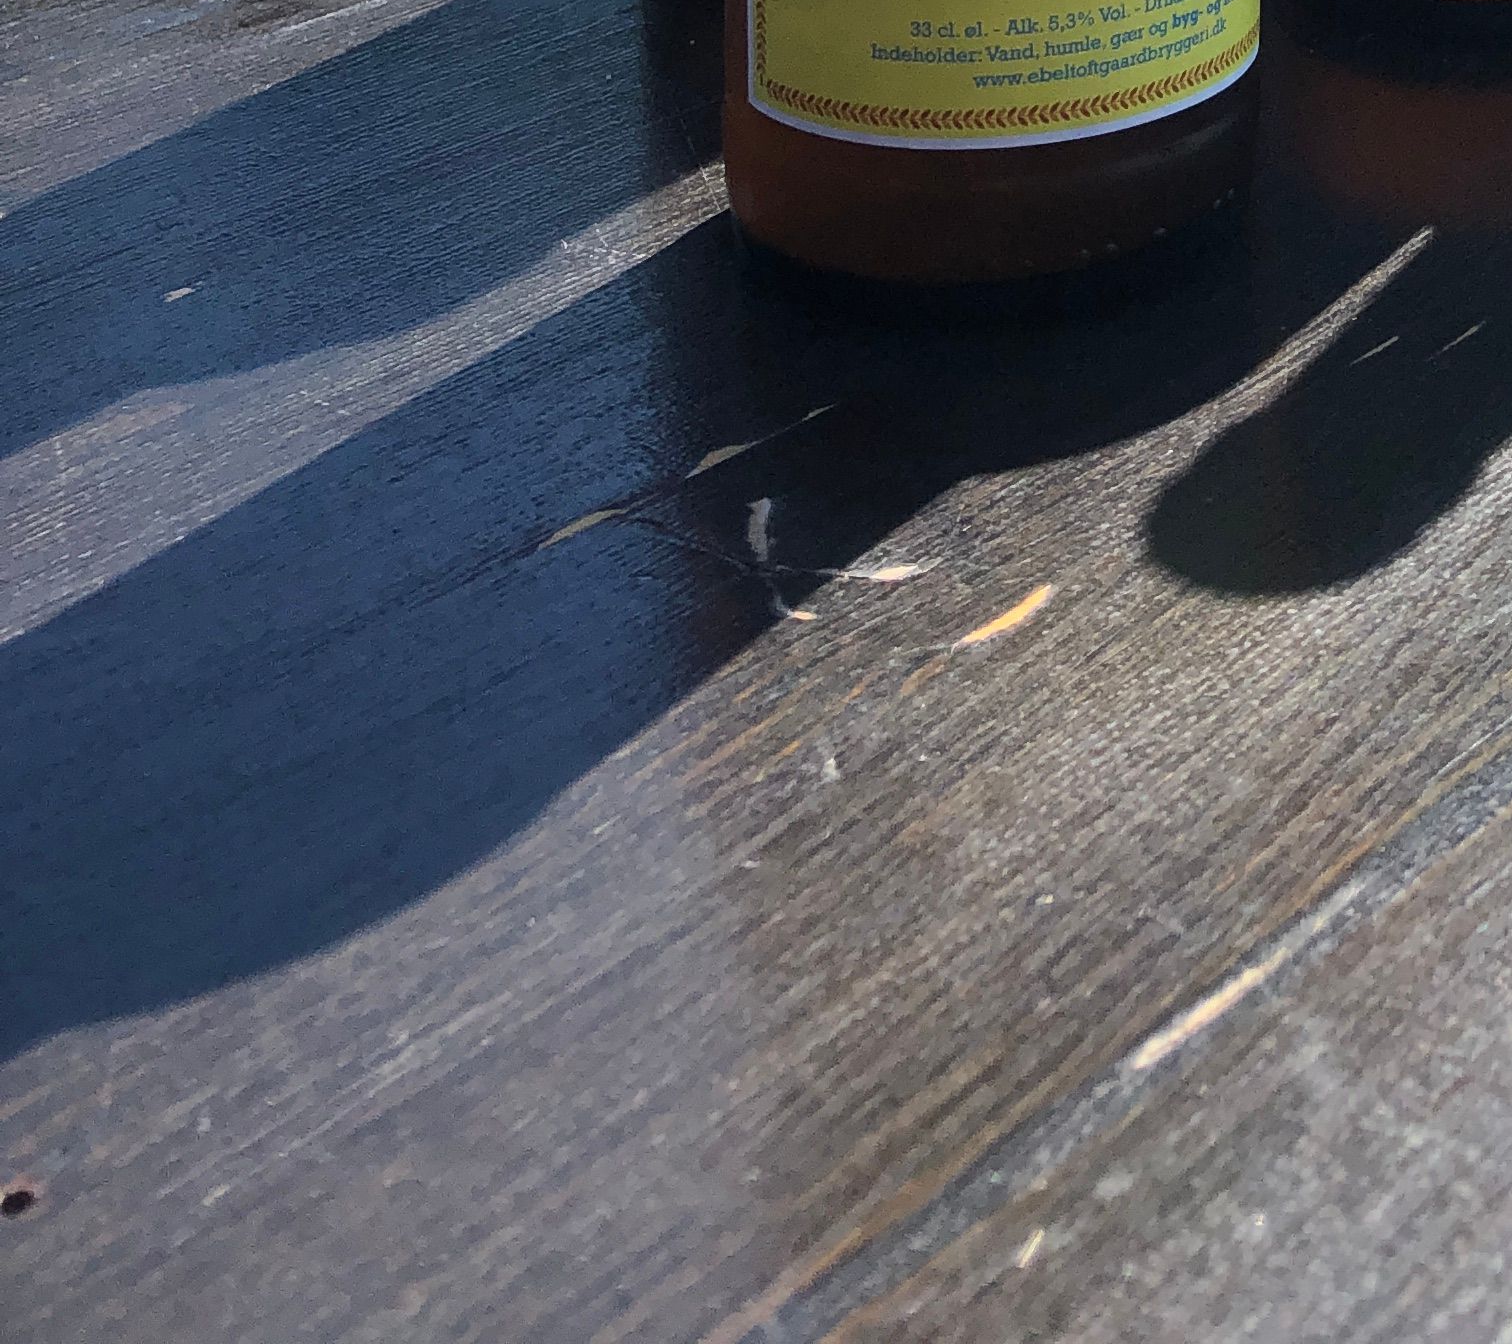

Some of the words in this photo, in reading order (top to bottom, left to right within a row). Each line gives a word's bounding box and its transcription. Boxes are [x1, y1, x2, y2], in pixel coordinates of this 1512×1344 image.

[870, 42, 983, 65] Indeholder:
[985, 42, 1039, 64] Vand,
[1110, 26, 1145, 50] gær
[1148, 19, 1169, 39] og
[1171, 8, 1204, 30] byg-
[910, 20, 932, 38] 33
[938, 20, 961, 38] cl.
[964, 21, 988, 39] øl.
[1048, 9, 1095, 33] 5,3%
[1098, 3, 1131, 23] Vol.
[973, 18, 1228, 90] www.ebeltoftgaardbryggeri.dk
